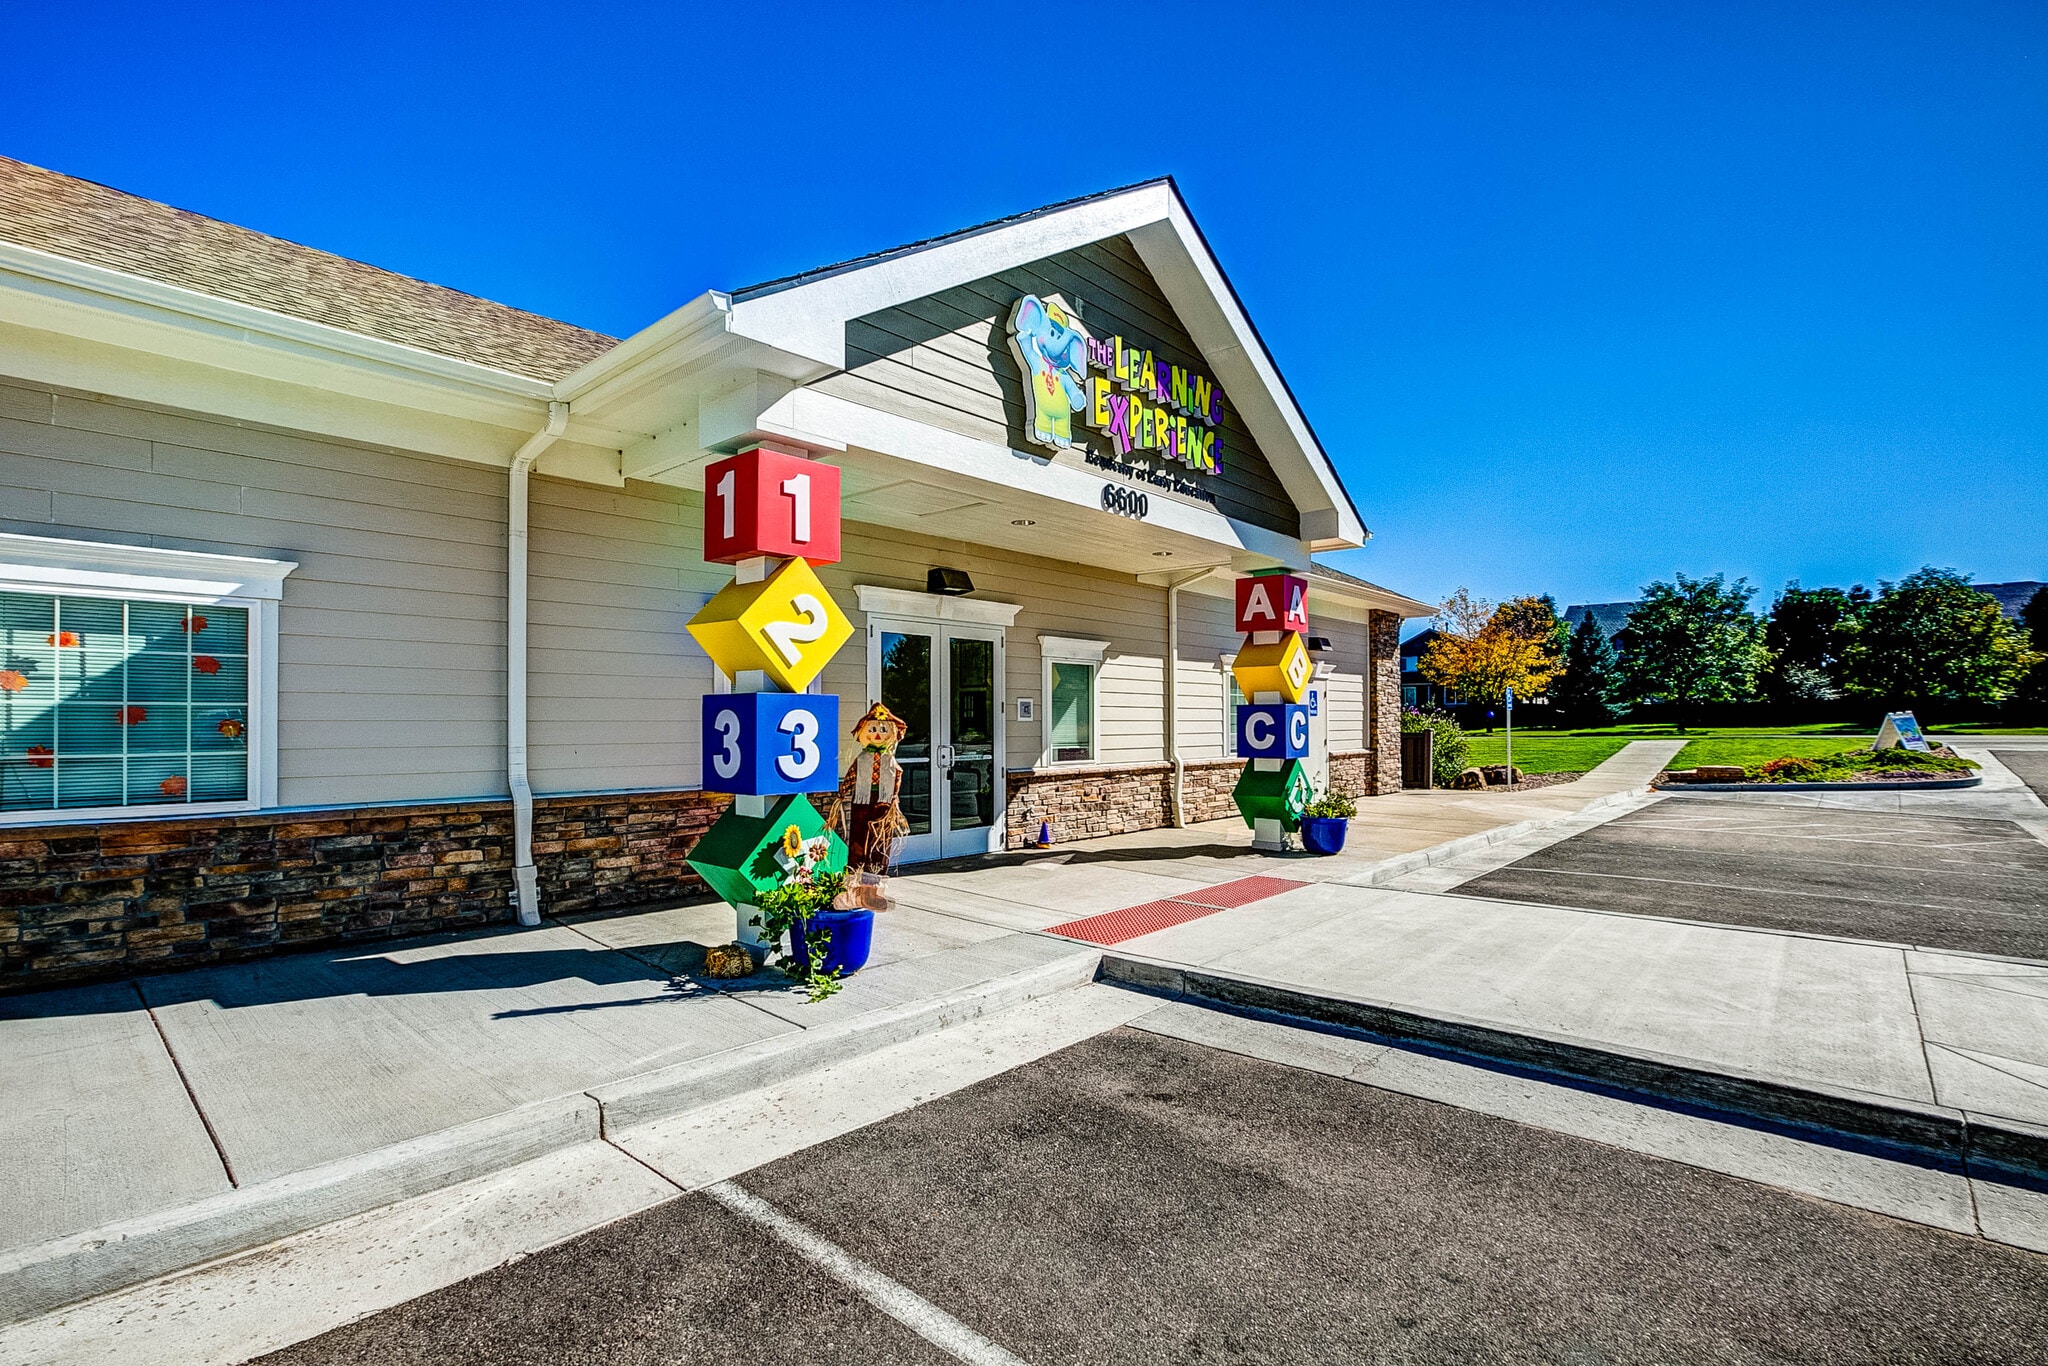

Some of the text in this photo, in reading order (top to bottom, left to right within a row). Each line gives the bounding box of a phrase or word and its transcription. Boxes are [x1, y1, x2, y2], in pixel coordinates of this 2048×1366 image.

[1087, 337, 1114, 367] THE
[716, 470, 736, 539] 1
[782, 473, 811, 543] 1
[1103, 483, 1149, 517] 6600
[1242, 583, 1276, 621] A
[1288, 585, 1307, 624] A
[761, 592, 828, 668] 2
[1287, 646, 1307, 689] B
[713, 708, 742, 780] 3
[777, 709, 821, 780] 3
[1245, 711, 1276, 750] C
[1290, 711, 1307, 750] C
